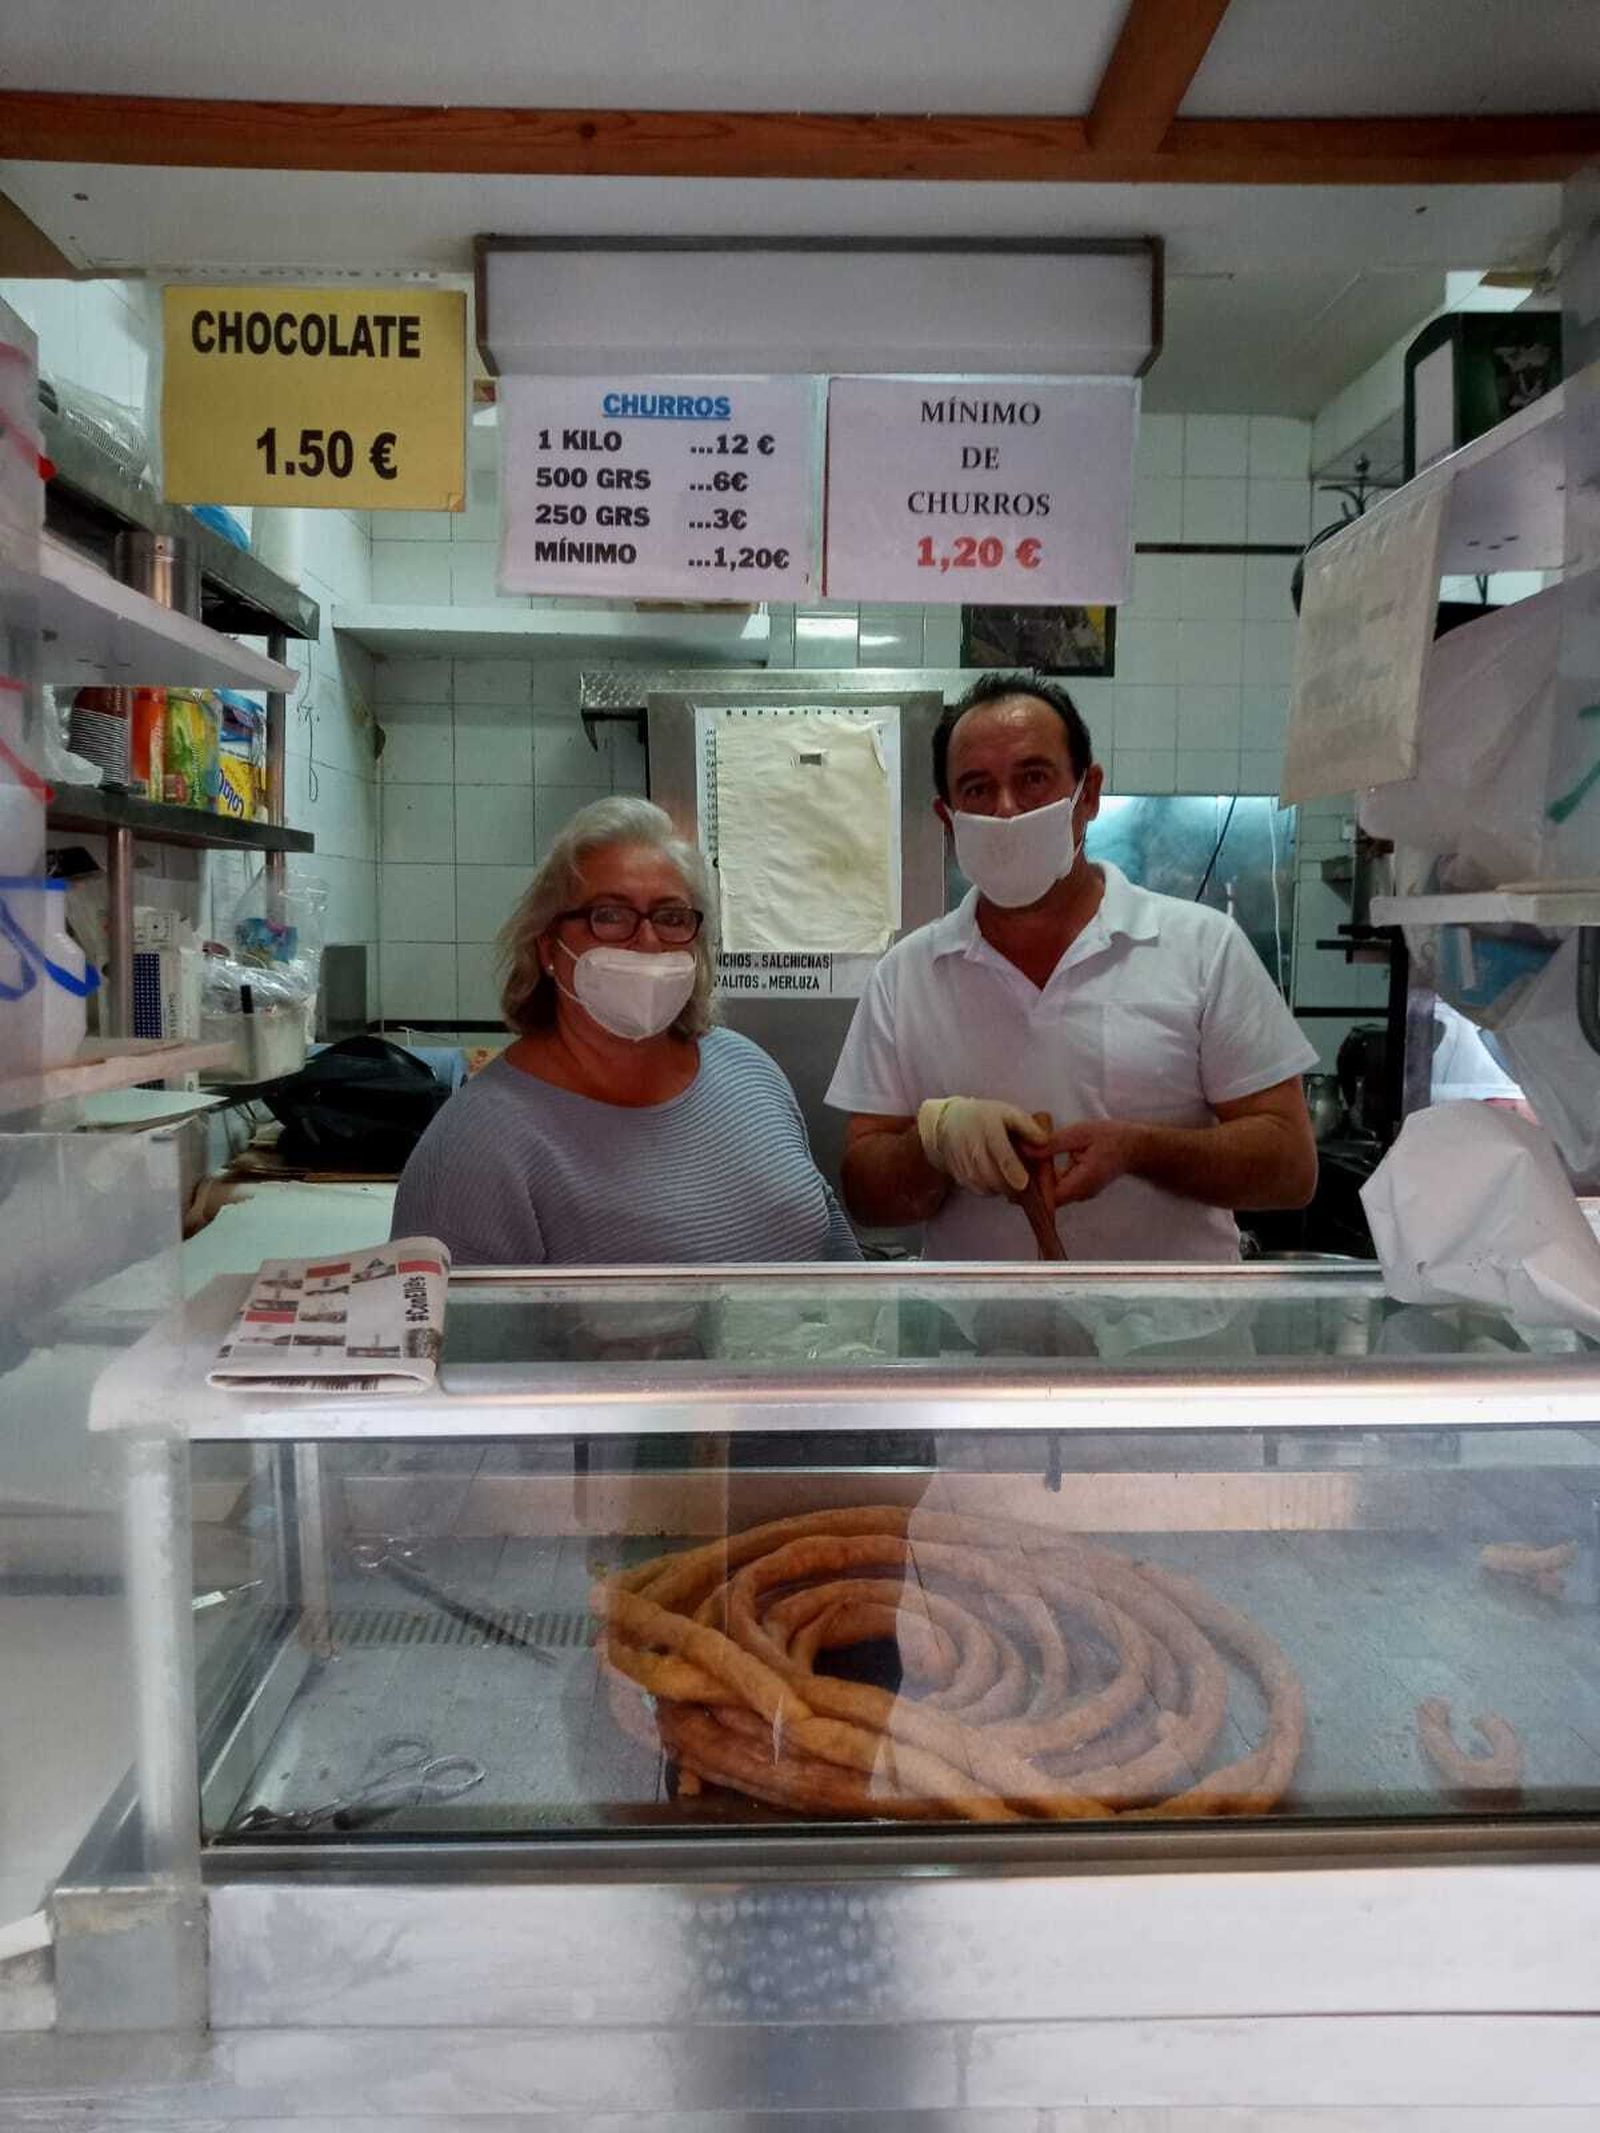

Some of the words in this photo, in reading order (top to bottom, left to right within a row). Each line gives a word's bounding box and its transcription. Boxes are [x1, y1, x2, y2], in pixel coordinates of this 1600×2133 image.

[192, 310, 421, 358] CHOCOLATE
[603, 393, 731, 419] CHURROS
[921, 396, 1041, 425] MÍNIMO
[256, 428, 353, 478] 1.50
[369, 432, 397, 480] €
[538, 430, 550, 450] 1
[563, 430, 622, 451] KILO
[758, 435, 775, 455] €
[961, 447, 1000, 470] DE
[536, 468, 588, 488] 500
[597, 468, 651, 490] GRS
[535, 505, 587, 526] 250
[596, 505, 650, 527] GRS
[907, 491, 1050, 516] CHURROS
[534, 538, 637, 564] MÍNIMO
[917, 536, 1004, 573] 1,20
[1015, 538, 1043, 569] €
[762, 954, 830, 969] SALCHICHAS
[769, 975, 820, 991] MERLUZA
